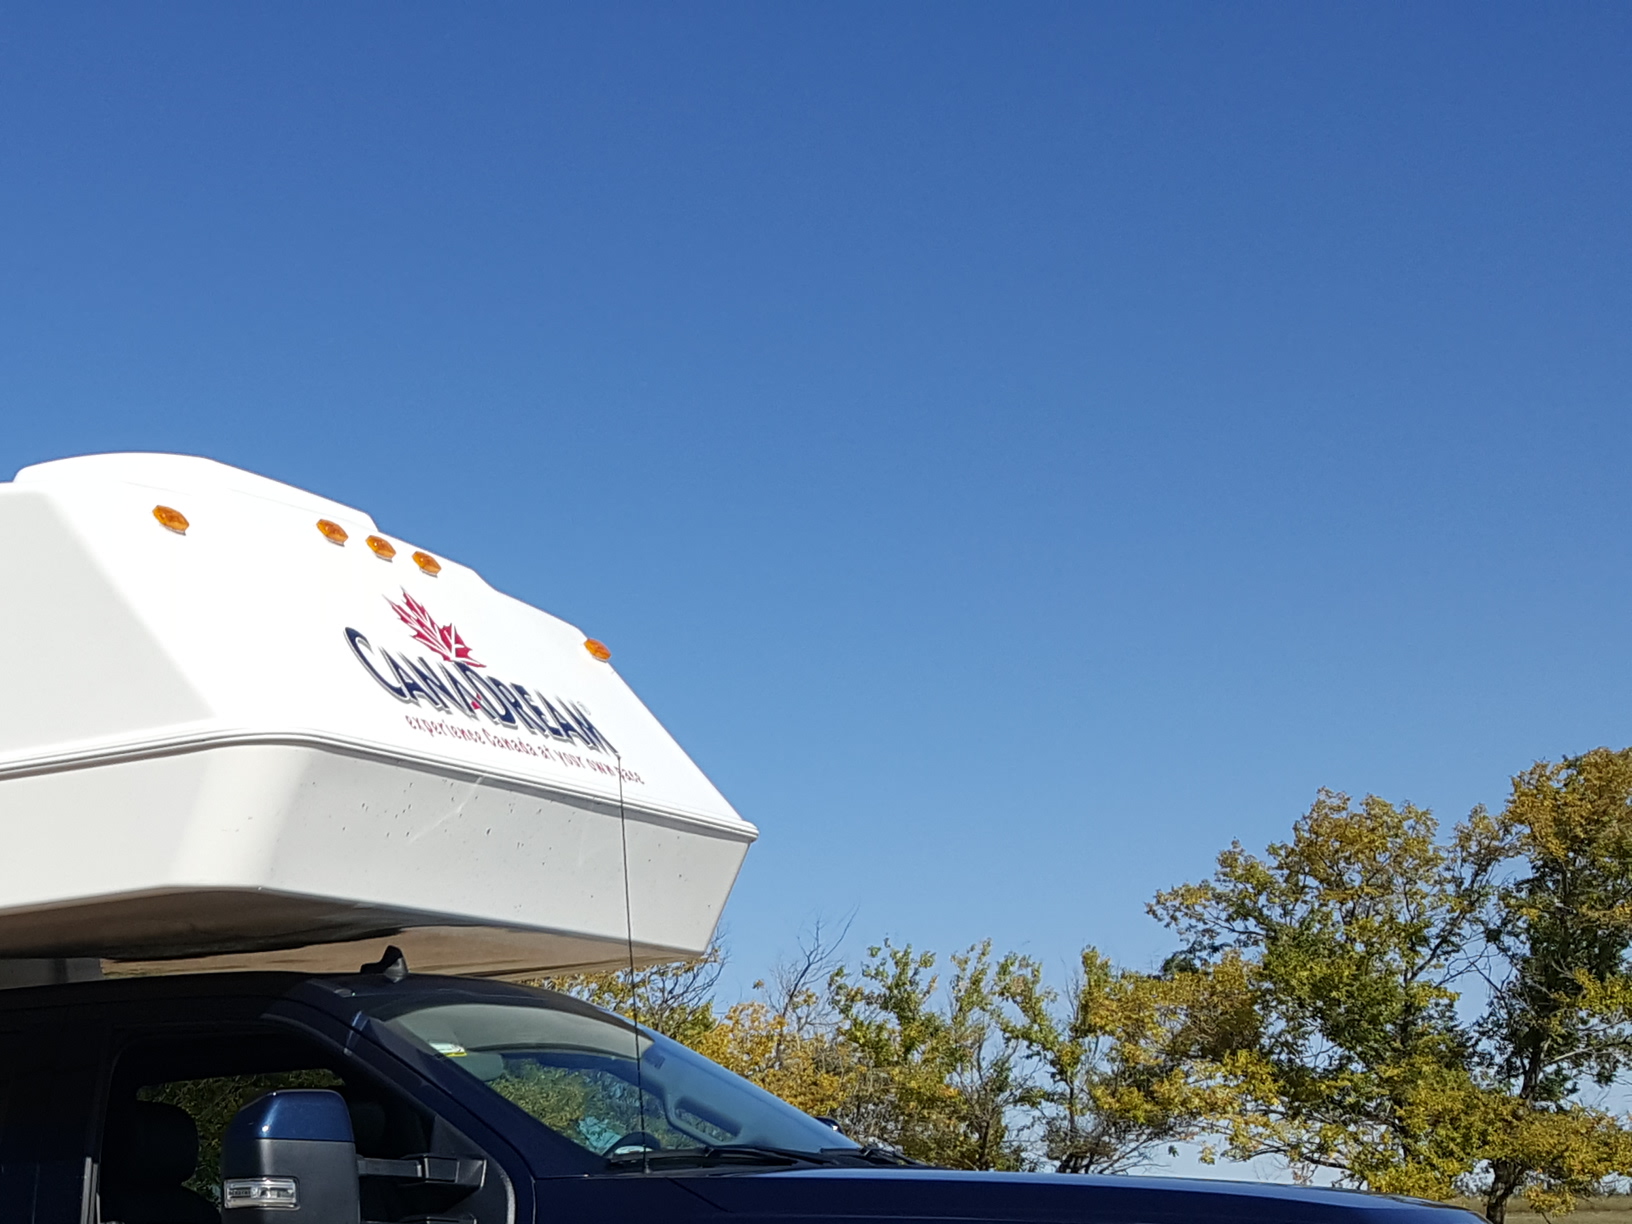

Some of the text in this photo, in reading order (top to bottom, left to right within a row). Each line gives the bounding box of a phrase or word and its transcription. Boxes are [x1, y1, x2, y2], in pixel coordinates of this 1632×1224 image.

[405, 714, 486, 745] experience
[481, 727, 539, 757] Canada
[537, 743, 556, 762] at
[553, 748, 586, 769] your
[585, 757, 616, 777] own
